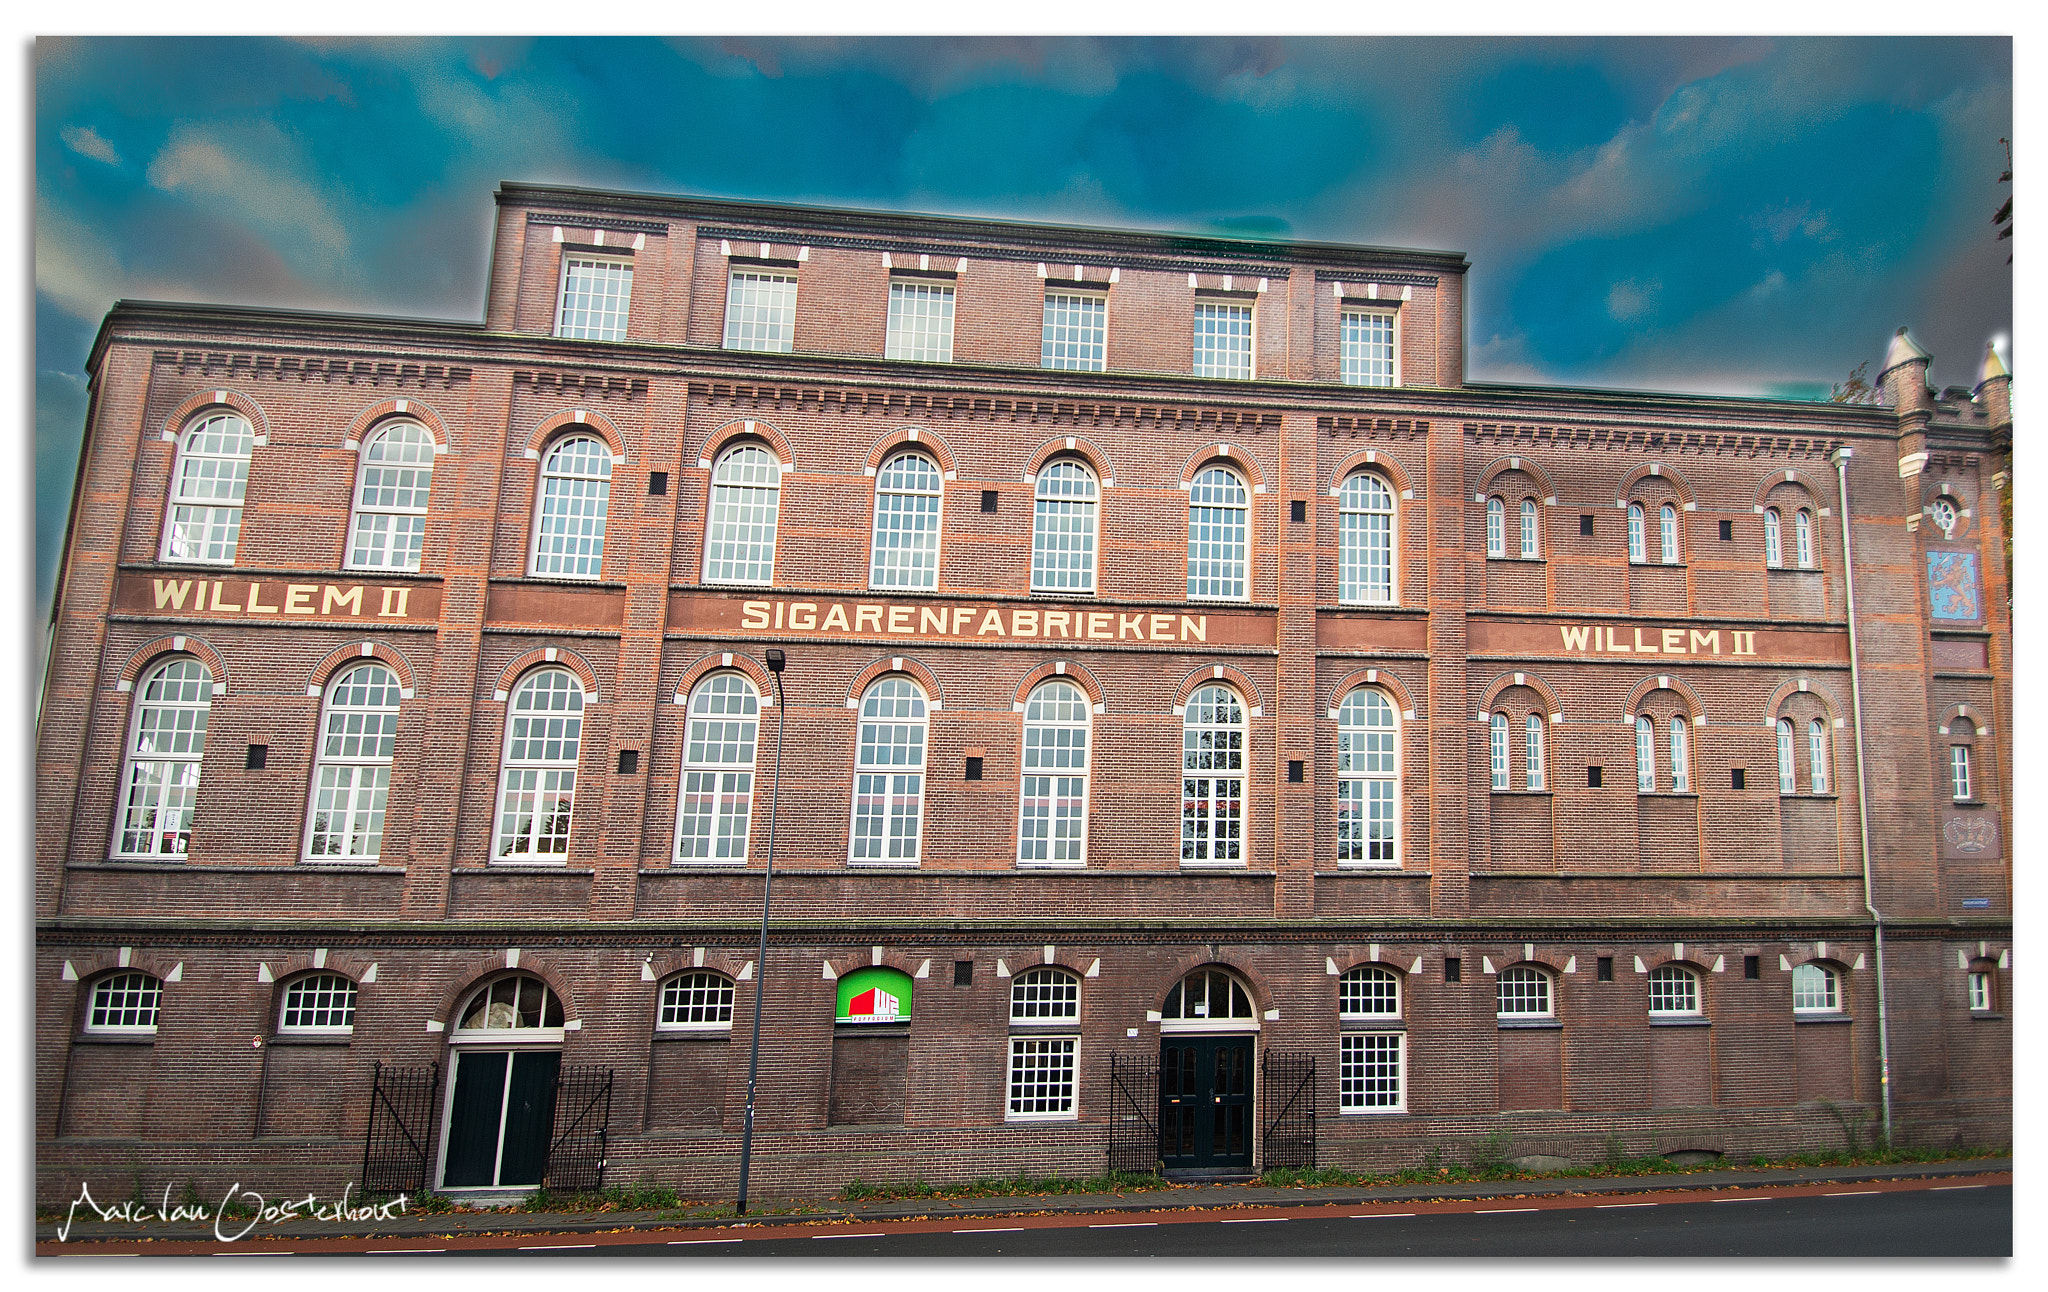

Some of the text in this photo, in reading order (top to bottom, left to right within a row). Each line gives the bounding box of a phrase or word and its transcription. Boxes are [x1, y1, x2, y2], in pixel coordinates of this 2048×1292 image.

[153, 579, 411, 617] WILLEM II
[740, 600, 1208, 642] SIGARENFABRIEKEN
[1560, 626, 1757, 655] WILLEM II
